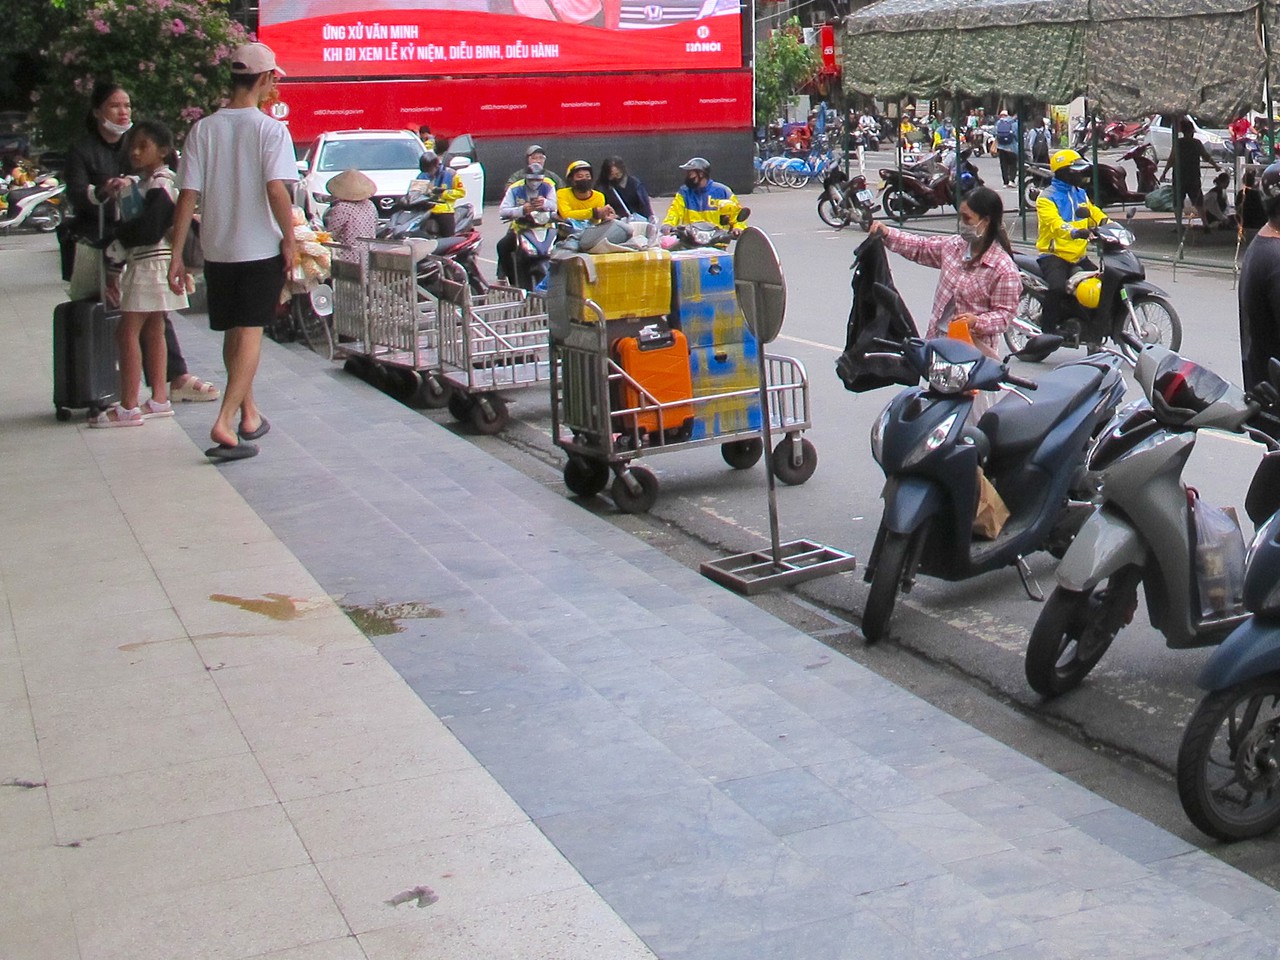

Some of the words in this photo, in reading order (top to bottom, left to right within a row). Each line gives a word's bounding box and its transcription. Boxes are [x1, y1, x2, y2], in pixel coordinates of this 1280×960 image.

[323, 23, 346, 40] ỨNG
[348, 21, 364, 40] XỬ
[365, 23, 389, 40] VĂN
[390, 25, 418, 39] MINH
[323, 47, 342, 61] KHI
[345, 47, 356, 61] ĐI
[358, 46, 383, 61] XEM
[385, 41, 398, 61] LỄ
[400, 42, 415, 61] KỶ
[417, 43, 447, 62] NIỆM,
[450, 40, 473, 60] DIỄU
[476, 45, 503, 60] BINH,
[505, 40, 529, 59] DIỄU
[531, 42, 559, 59] HÀNH
